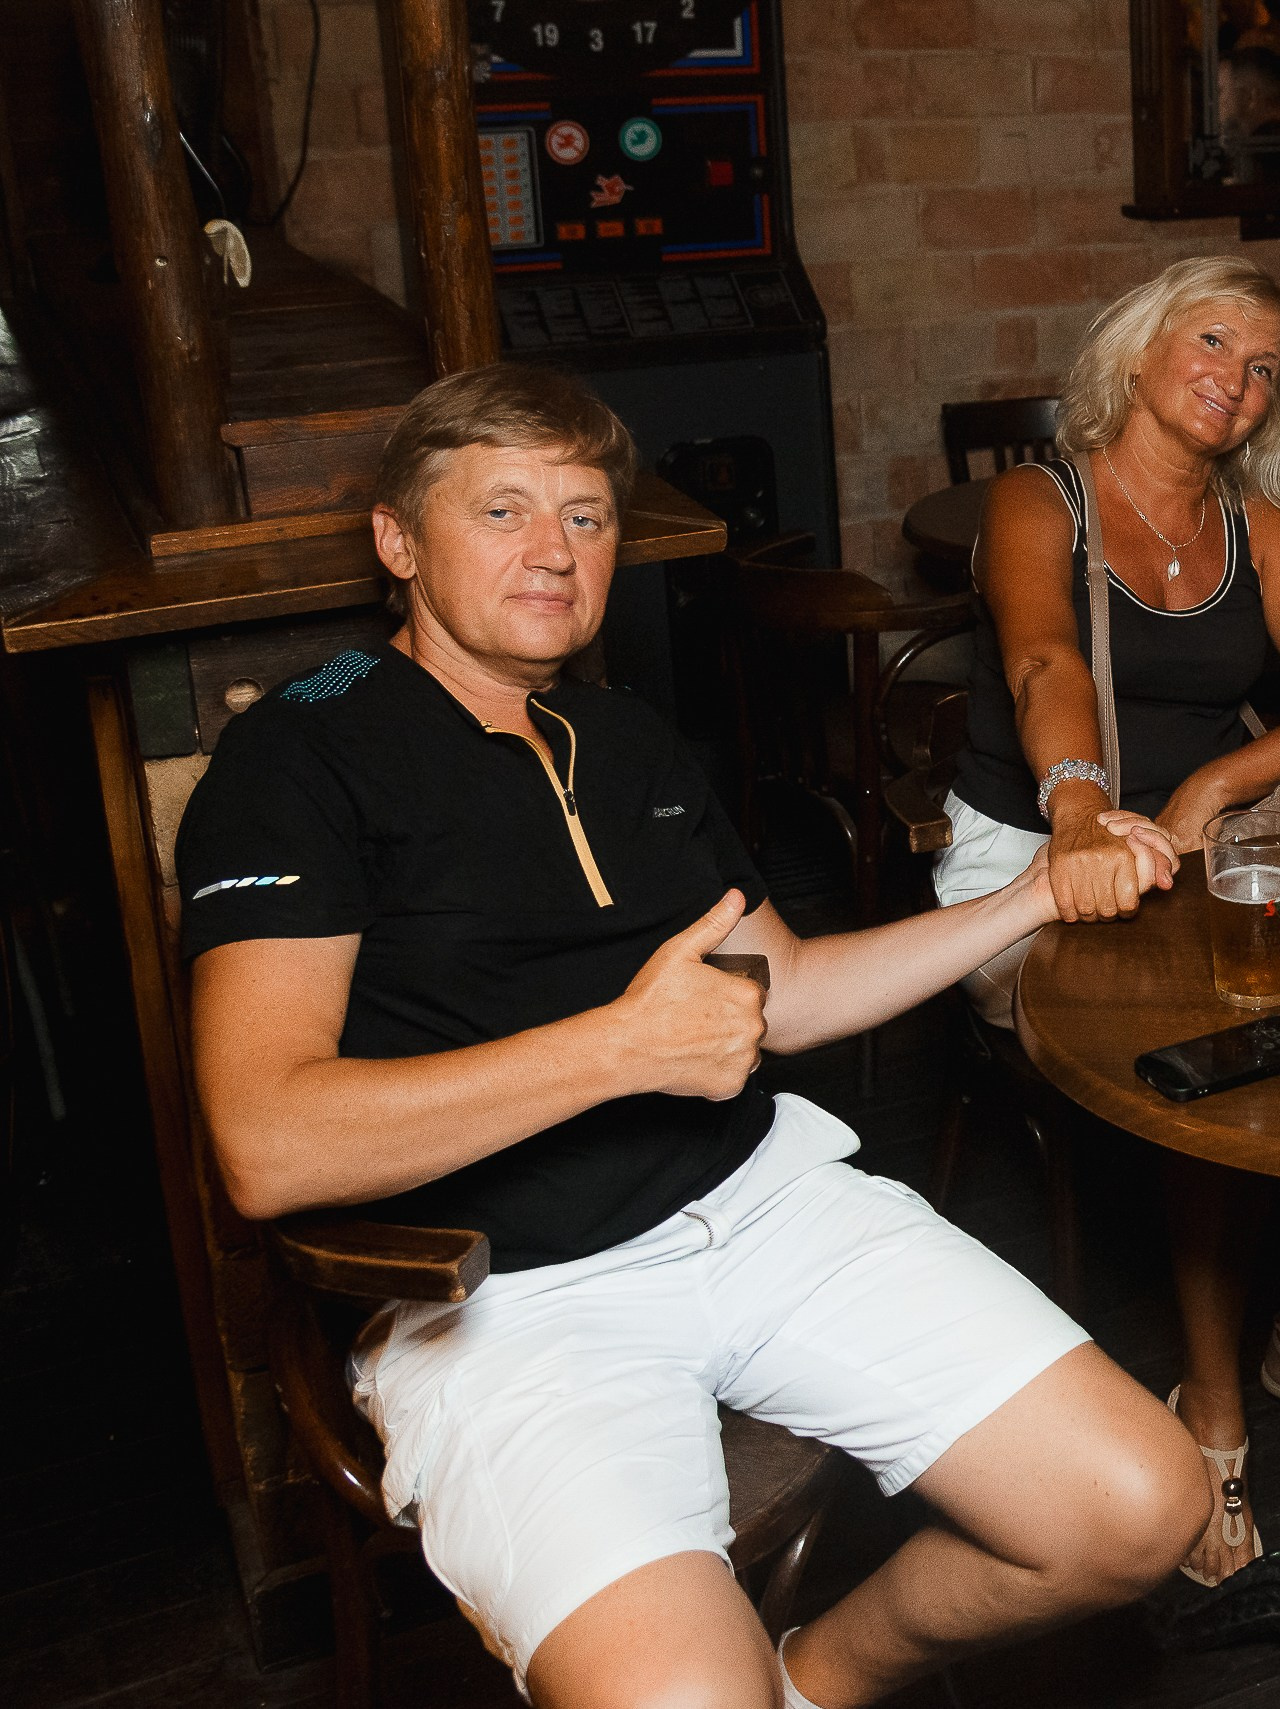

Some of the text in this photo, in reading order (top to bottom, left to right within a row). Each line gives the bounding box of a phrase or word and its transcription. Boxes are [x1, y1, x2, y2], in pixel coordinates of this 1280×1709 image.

[490, 0, 506, 22] 7
[680, 0, 695, 19] 2
[532, 22, 560, 47] 19
[588, 28, 604, 52] 3
[631, 21, 658, 44] 17
